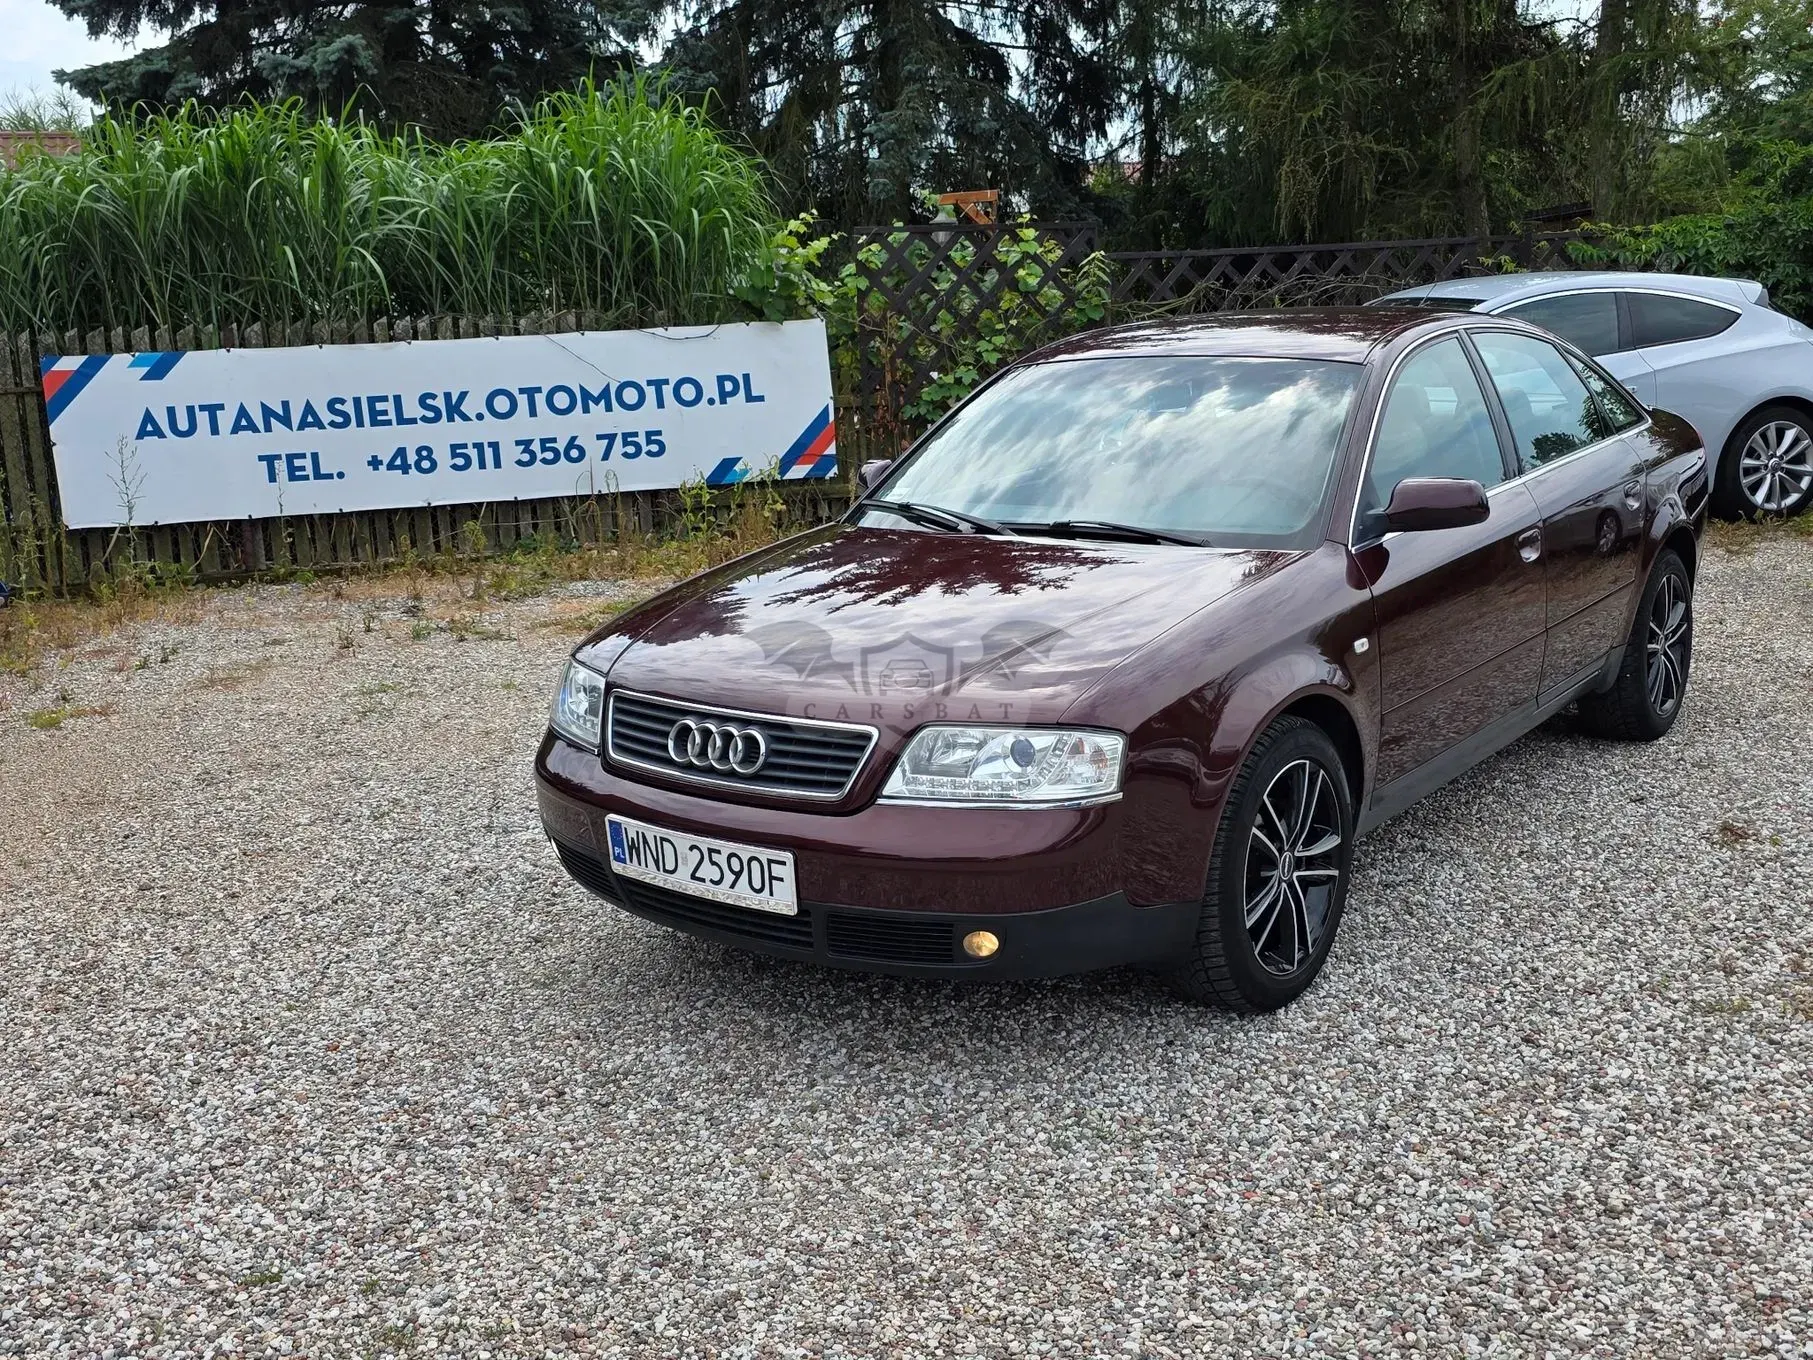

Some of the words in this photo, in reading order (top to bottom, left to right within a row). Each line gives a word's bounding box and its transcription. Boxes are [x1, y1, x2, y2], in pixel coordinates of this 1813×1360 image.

[135, 372, 766, 441] AUTANASIELSK.OTOMOTO.PL
[257, 451, 346, 484] TEL.
[366, 445, 439, 476] +48
[448, 440, 502, 472] 511
[514, 435, 587, 467] 356
[595, 429, 668, 462] 755
[614, 846, 626, 859] PL
[624, 827, 679, 875] WND
[688, 844, 787, 897] 2590F
